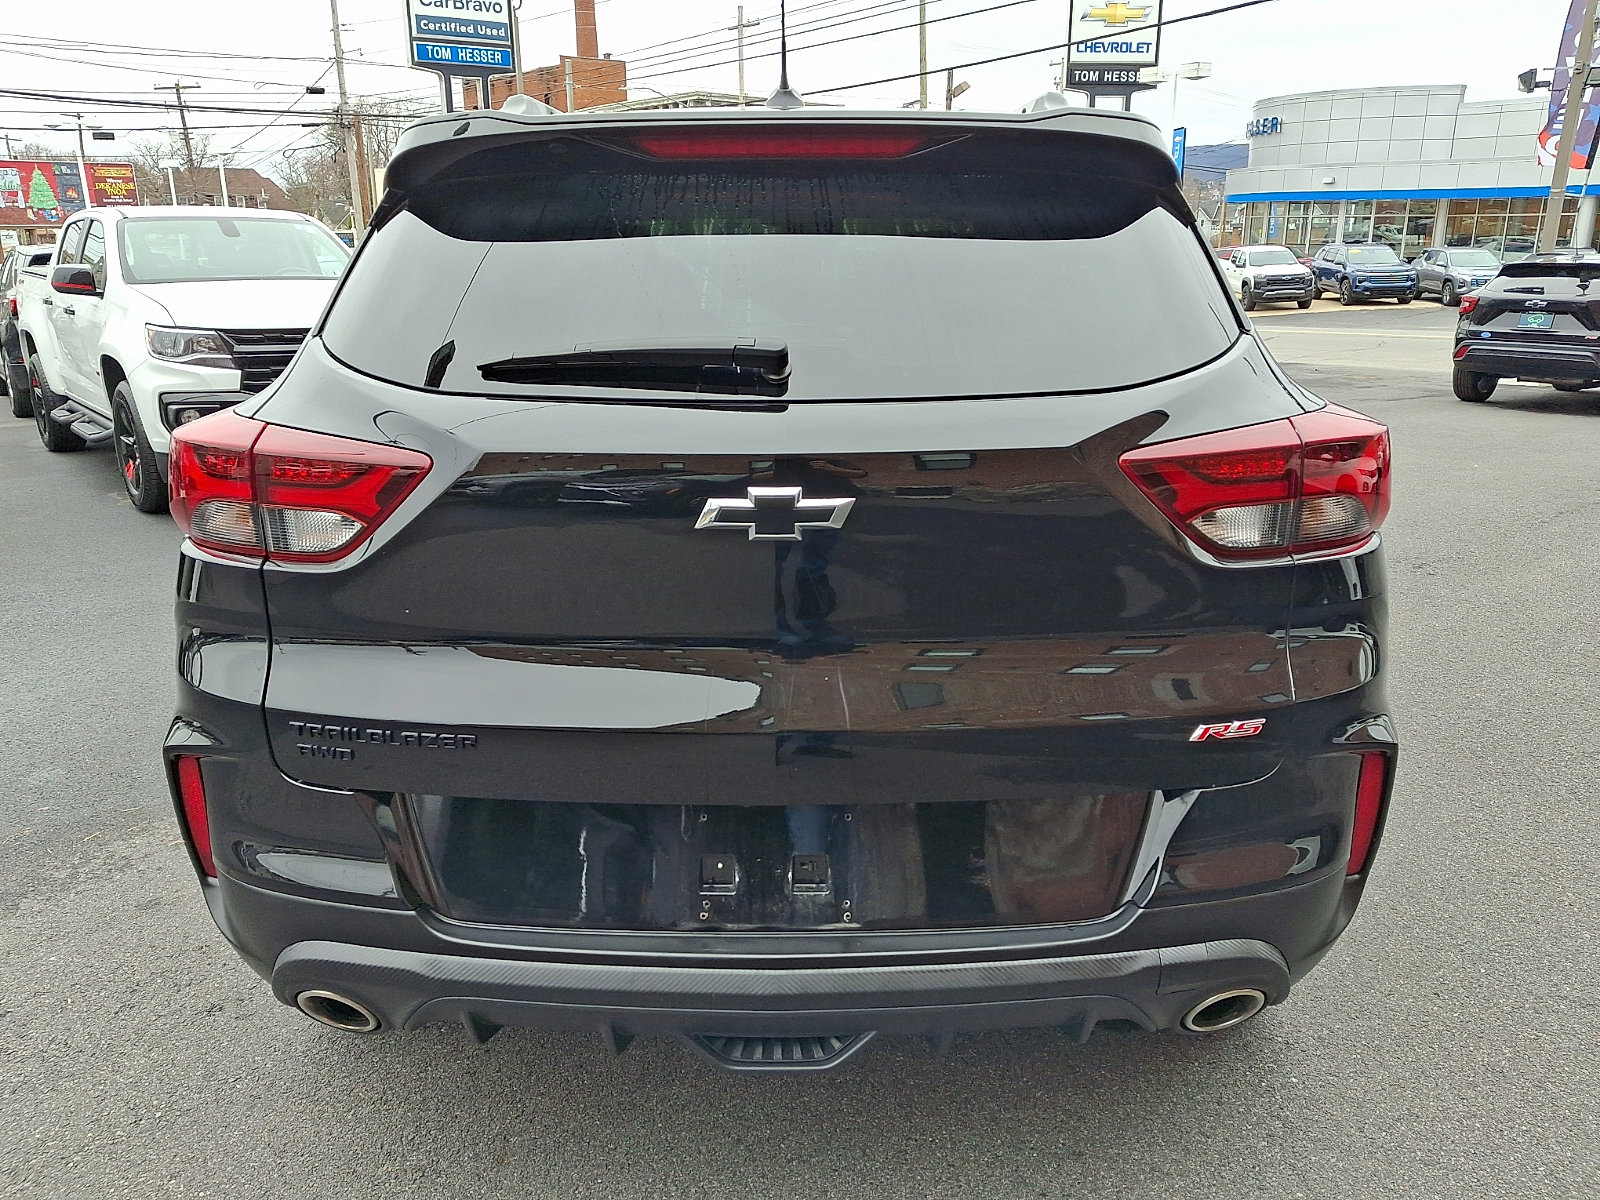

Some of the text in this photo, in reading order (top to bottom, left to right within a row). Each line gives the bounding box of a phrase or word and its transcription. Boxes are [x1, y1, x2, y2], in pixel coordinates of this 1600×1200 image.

[420, 20, 506, 37] Certified Used
[426, 46, 502, 63] TOM HESSER
[1076, 41, 1152, 53] CHEVROLET
[1074, 71, 1141, 82] TOM HESSE
[289, 721, 477, 750] TRAILBLAZER
[1189, 718, 1267, 742] RS
